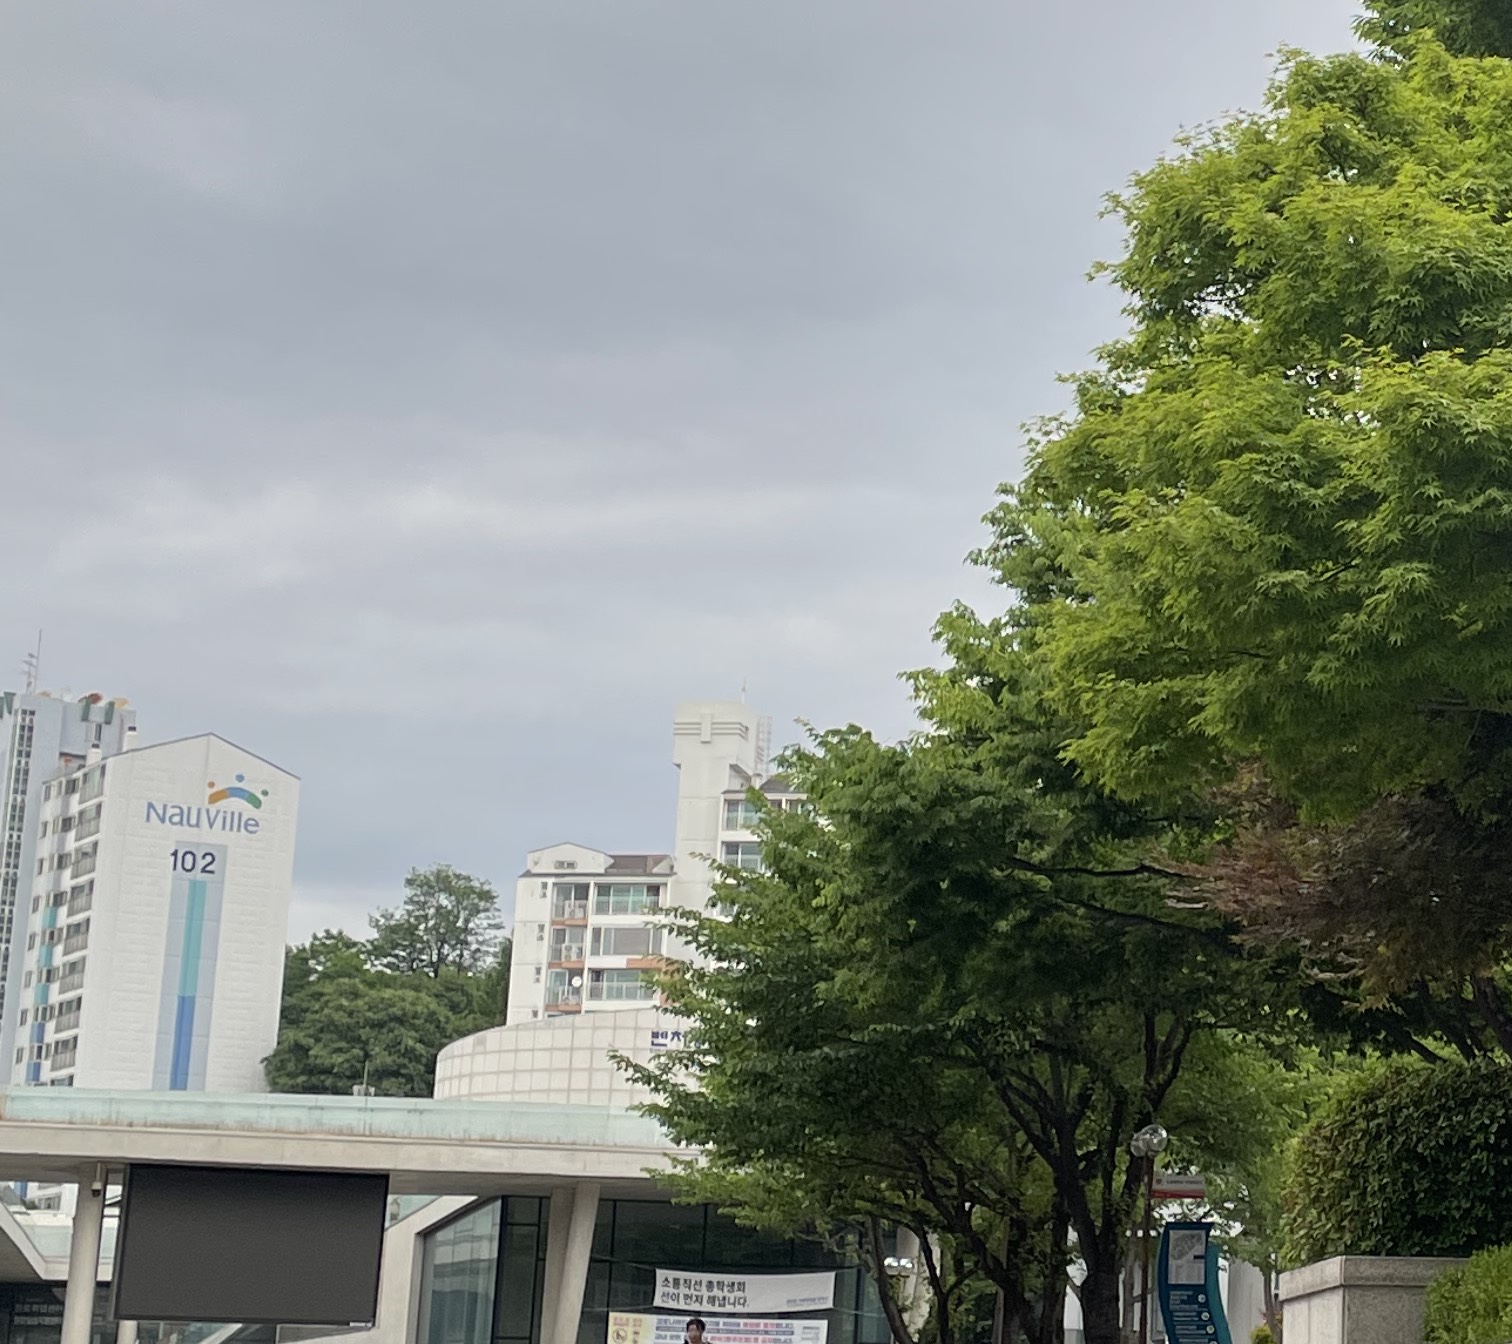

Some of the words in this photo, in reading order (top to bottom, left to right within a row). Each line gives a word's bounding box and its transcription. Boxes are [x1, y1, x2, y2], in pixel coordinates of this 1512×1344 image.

[145, 801, 260, 835] NauVille
[170, 849, 216, 874] 102
[683, 1292, 704, 1307] 먼저
